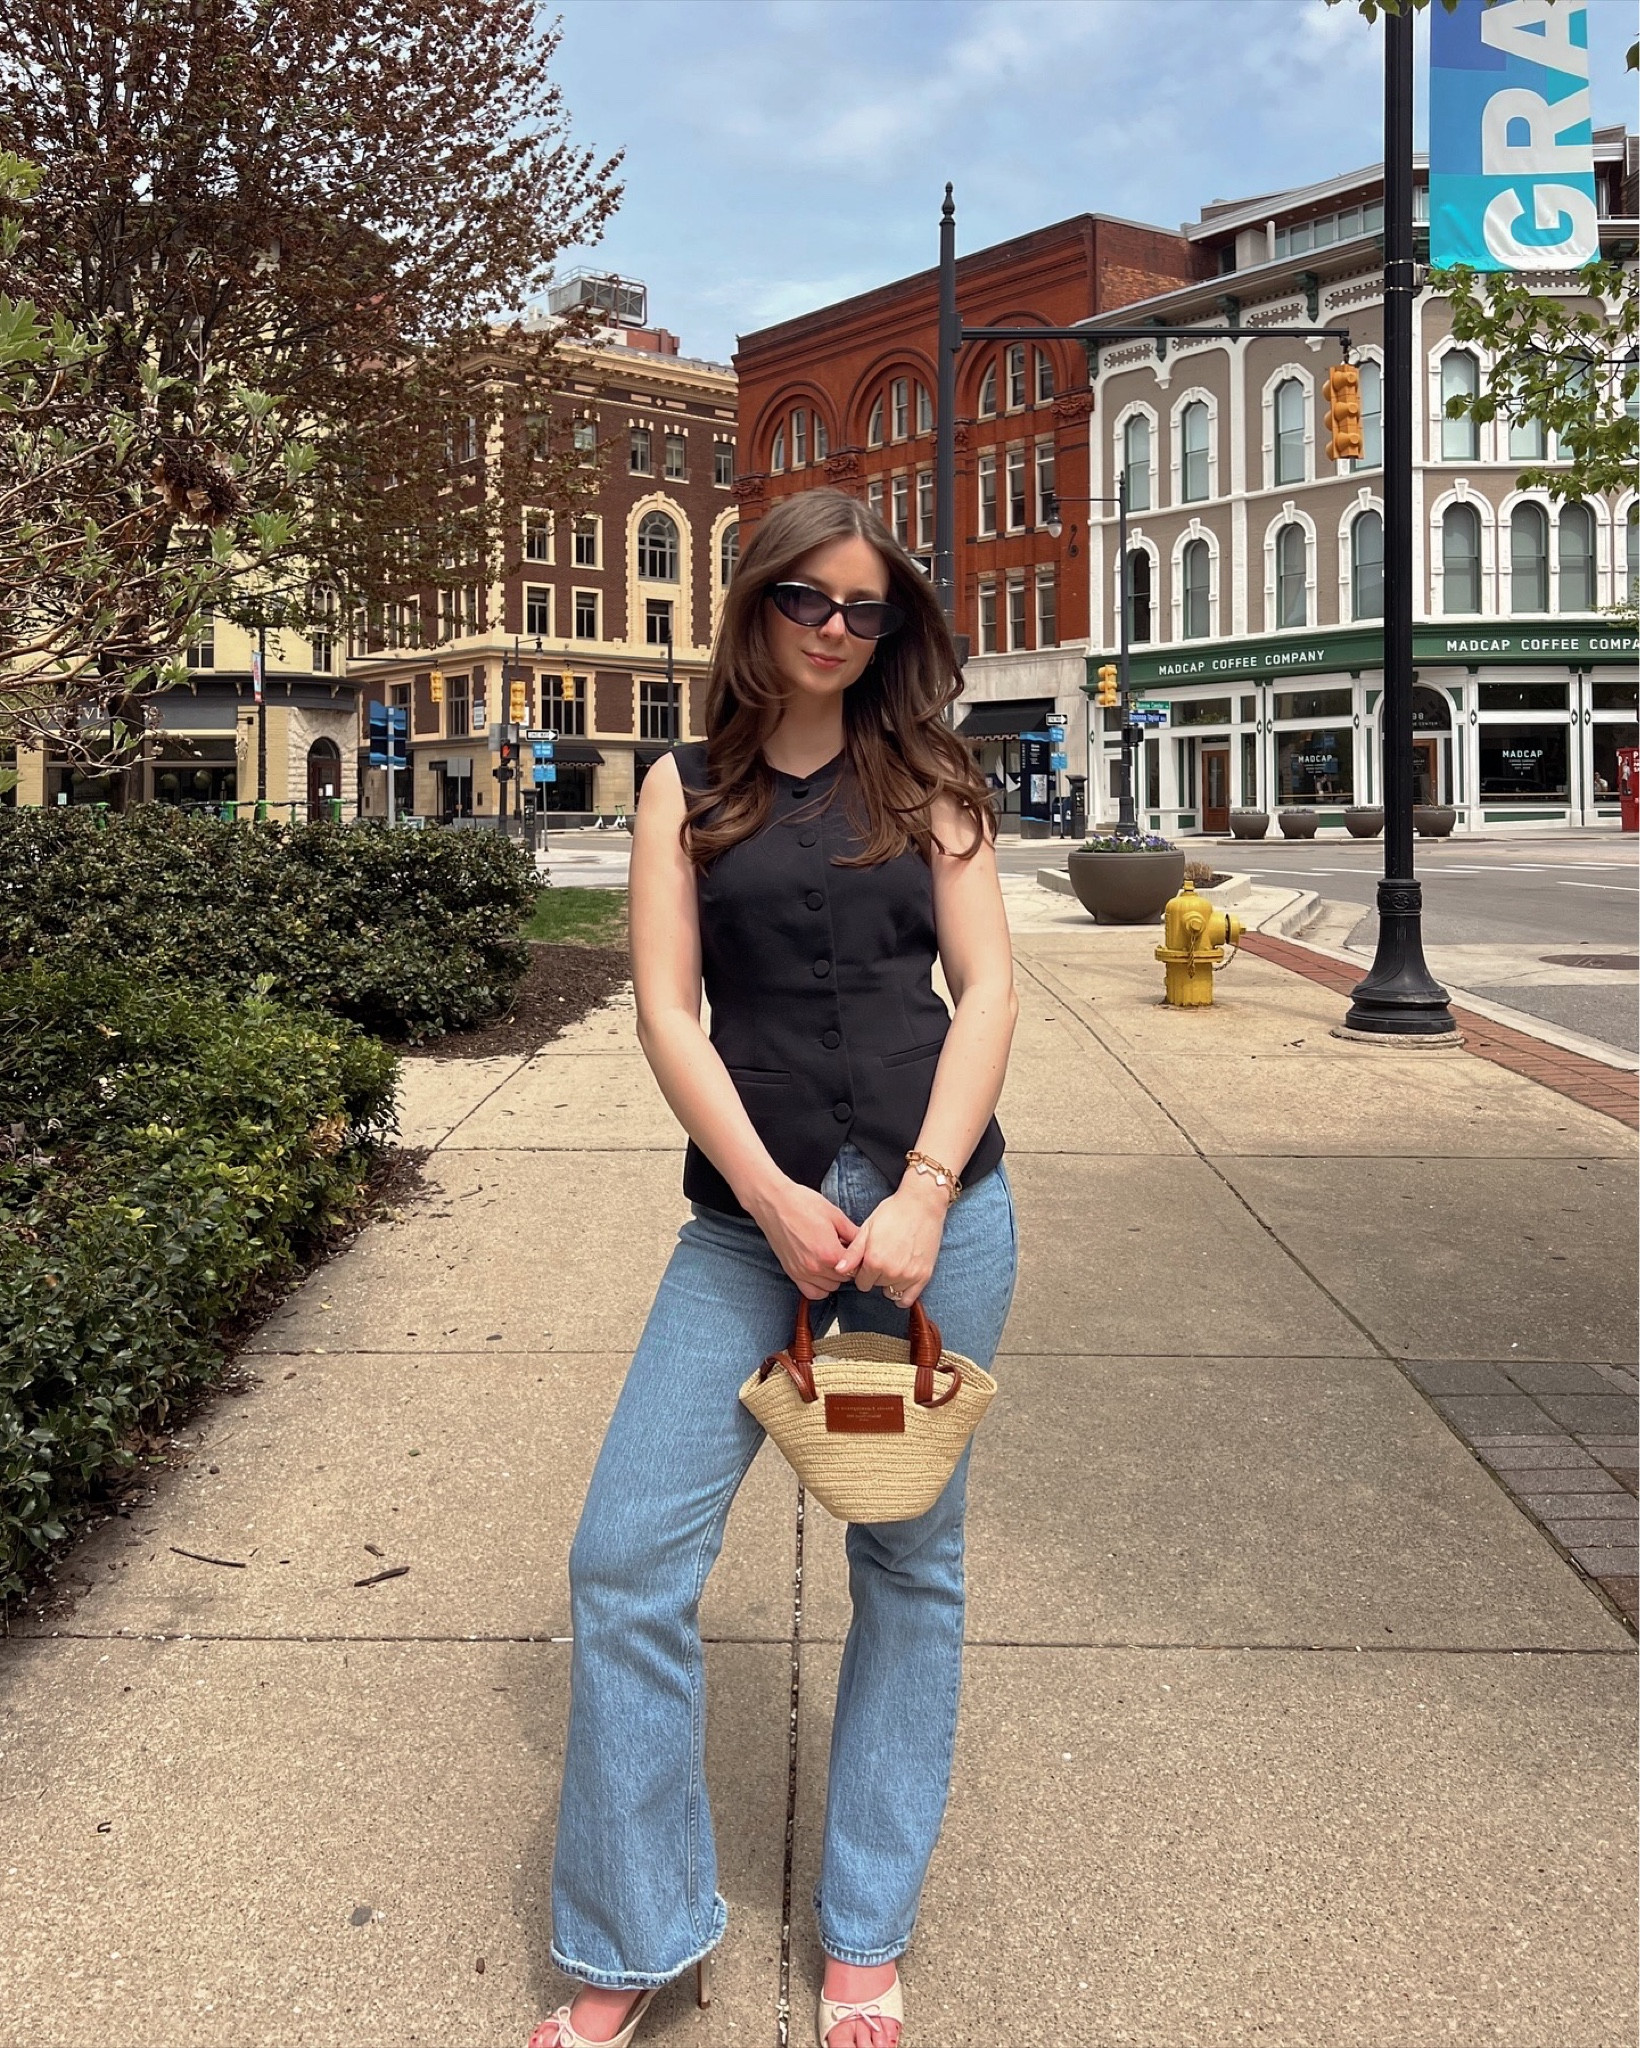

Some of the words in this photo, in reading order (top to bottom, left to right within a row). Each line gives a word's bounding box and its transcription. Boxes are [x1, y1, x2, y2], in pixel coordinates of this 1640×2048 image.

[1481, 0, 1600, 271] GRA
[1446, 639, 1511, 652] MADCAP
[1521, 638, 1580, 651] COFFEE
[1589, 638, 1639, 650] COMPA
[1158, 661, 1205, 676] MADCAP
[1212, 657, 1258, 670] COFFEE
[1265, 649, 1325, 666] COMPANY
[1298, 754, 1333, 763] MADCAP
[1502, 749, 1543, 758] MADCAP
